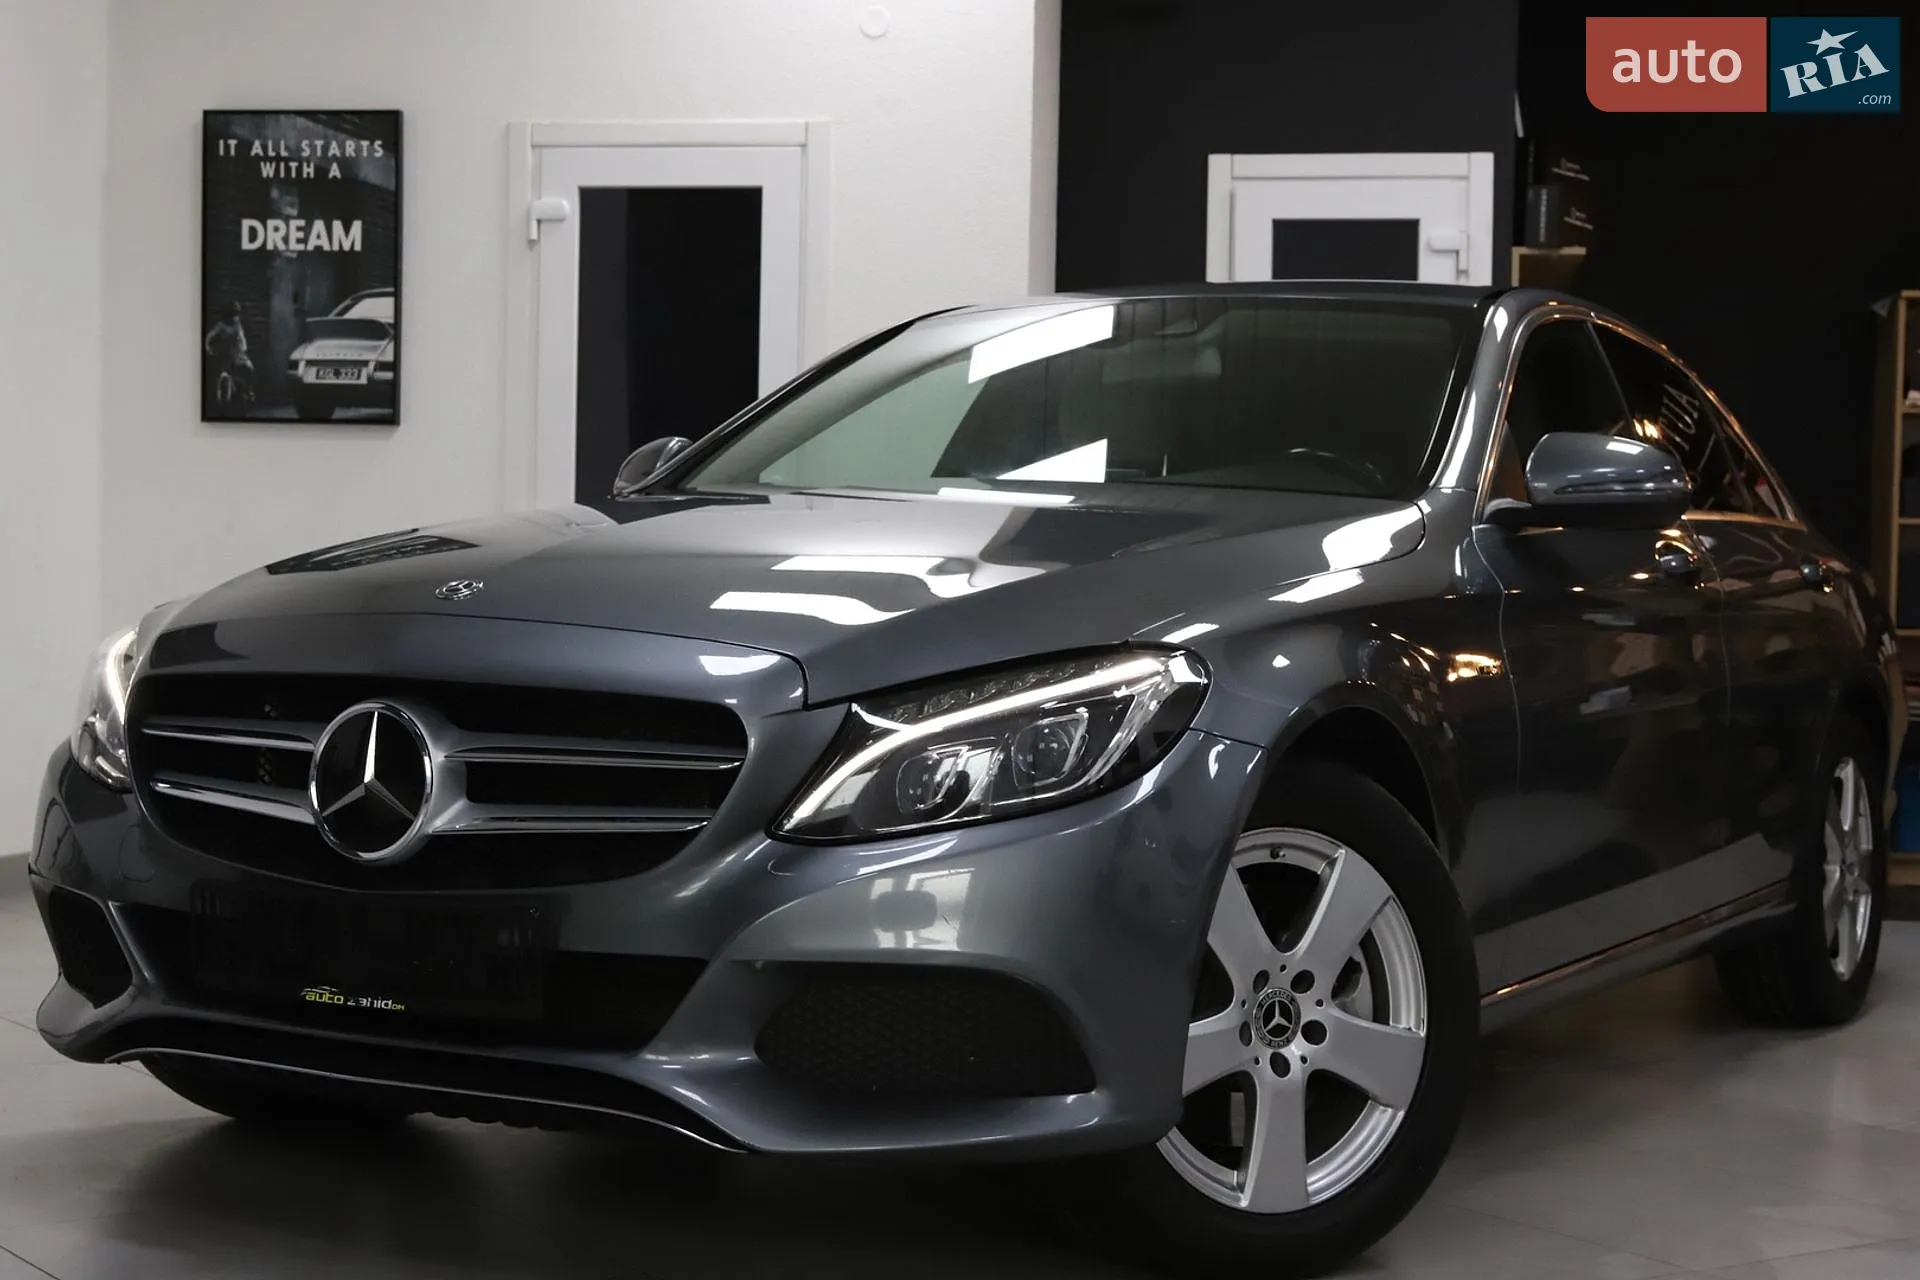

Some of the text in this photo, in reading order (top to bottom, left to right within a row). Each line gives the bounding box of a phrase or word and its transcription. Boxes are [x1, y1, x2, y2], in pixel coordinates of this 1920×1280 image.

[218, 139, 384, 158] IT ALL STARTS
[260, 162, 342, 179] WITH A
[240, 218, 363, 252] DREAM
[305, 992, 344, 1004] auto
